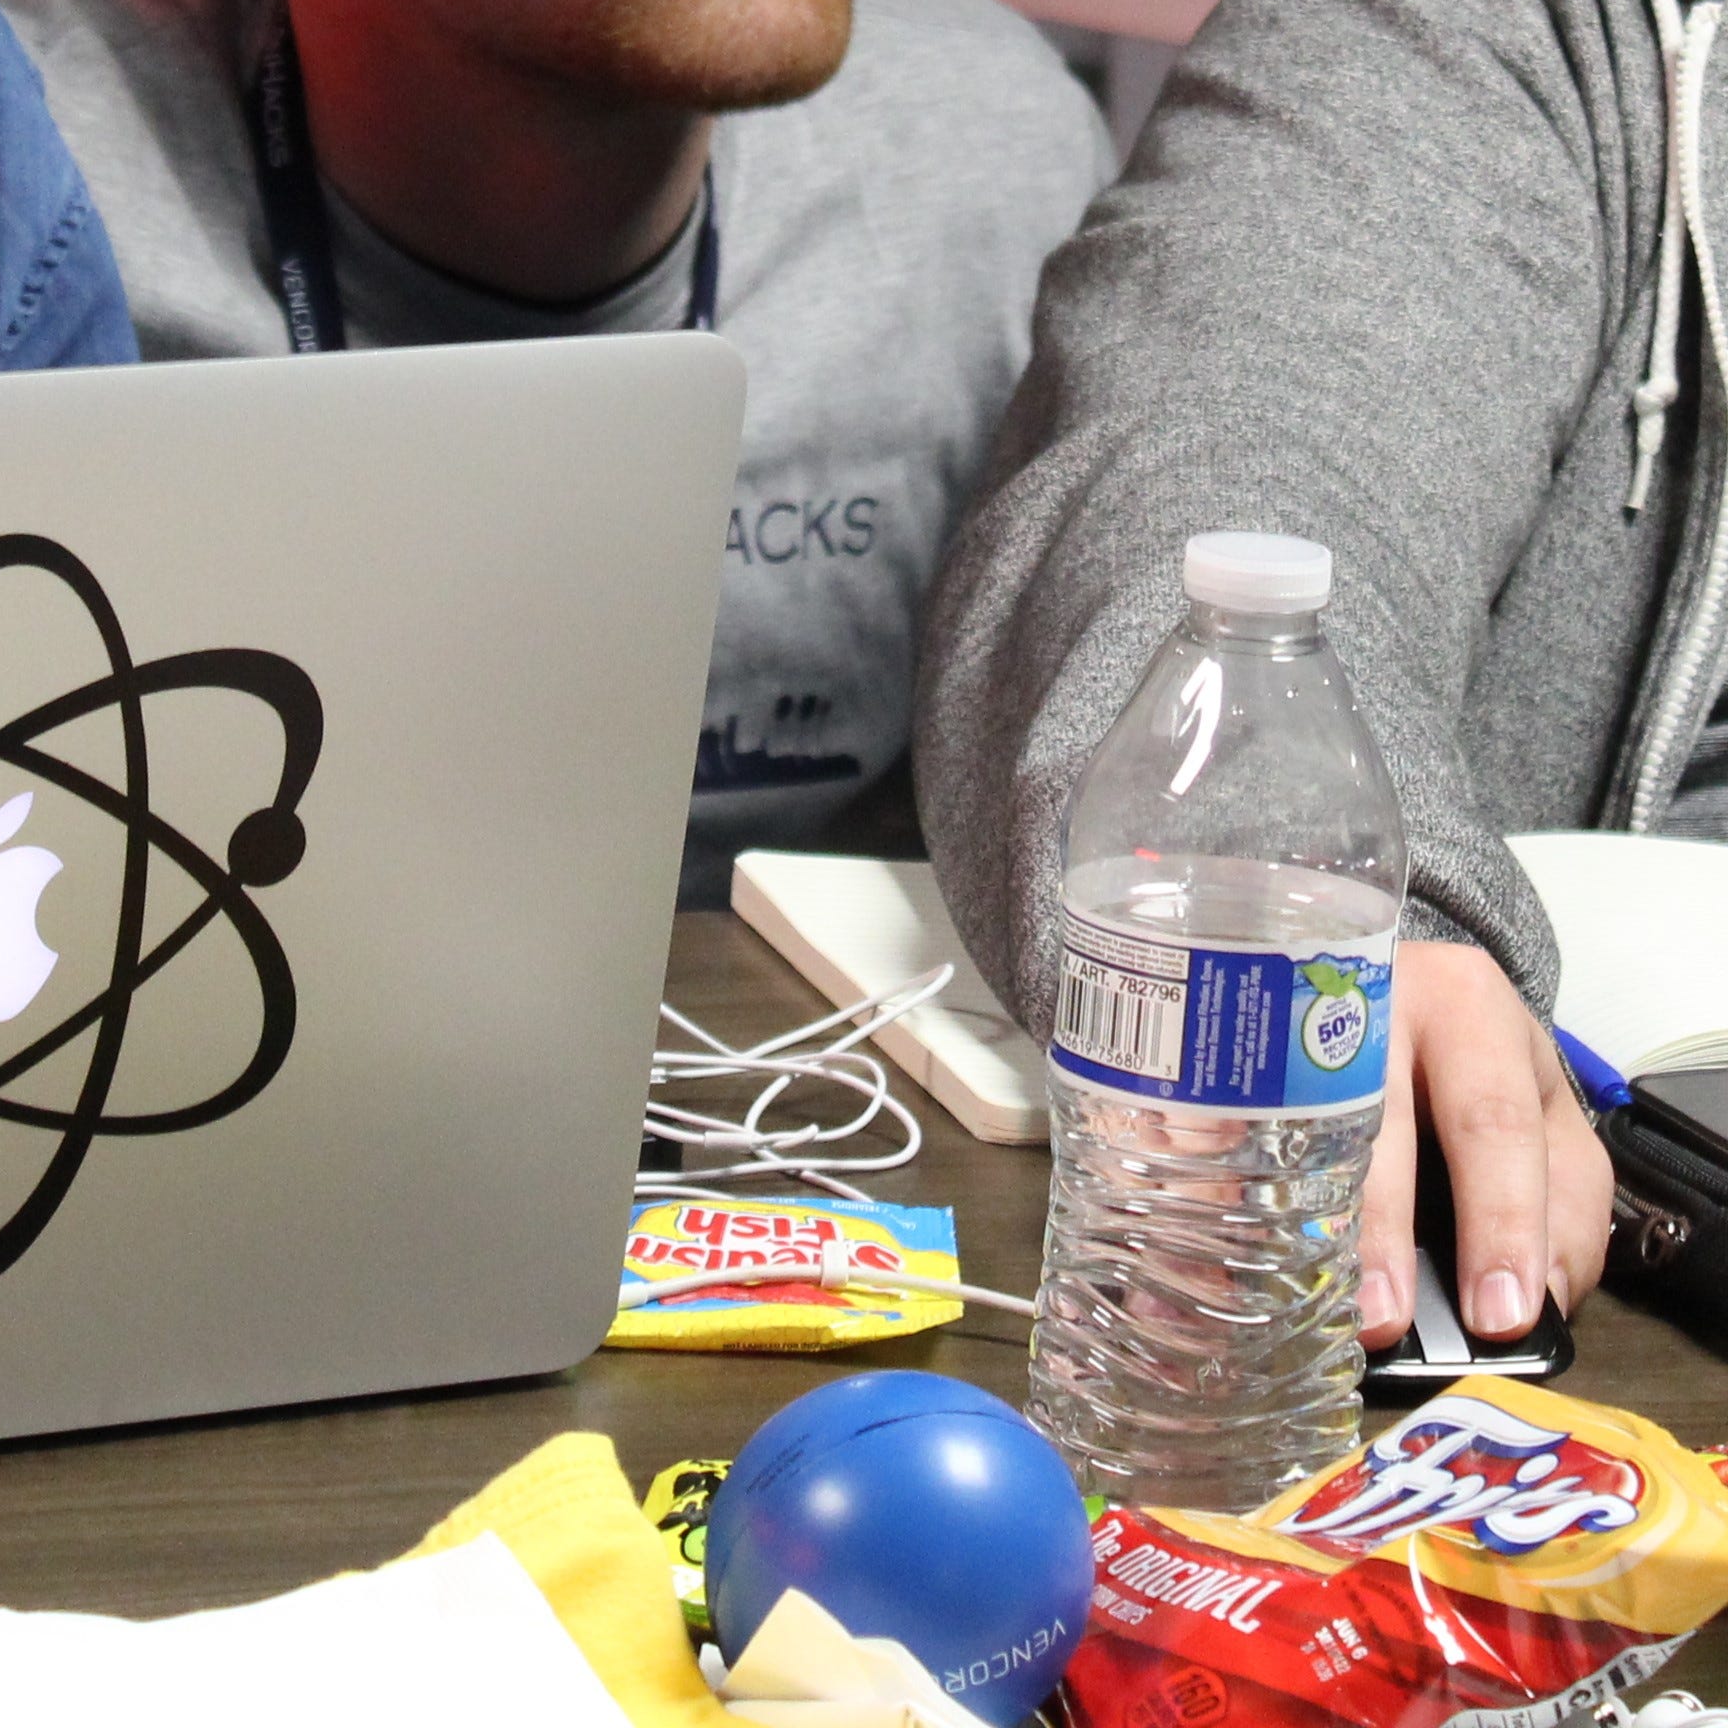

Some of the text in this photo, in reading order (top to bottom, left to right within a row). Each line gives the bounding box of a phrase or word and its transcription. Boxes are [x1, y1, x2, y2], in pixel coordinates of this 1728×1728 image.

[1118, 974, 1181, 1003] 782796
[1318, 1006, 1361, 1045] 50%
[1107, 1543, 1283, 1634] ORIGINAL
[1332, 1616, 1362, 1648] JUN
[931, 1616, 1068, 1694] VENCOR
